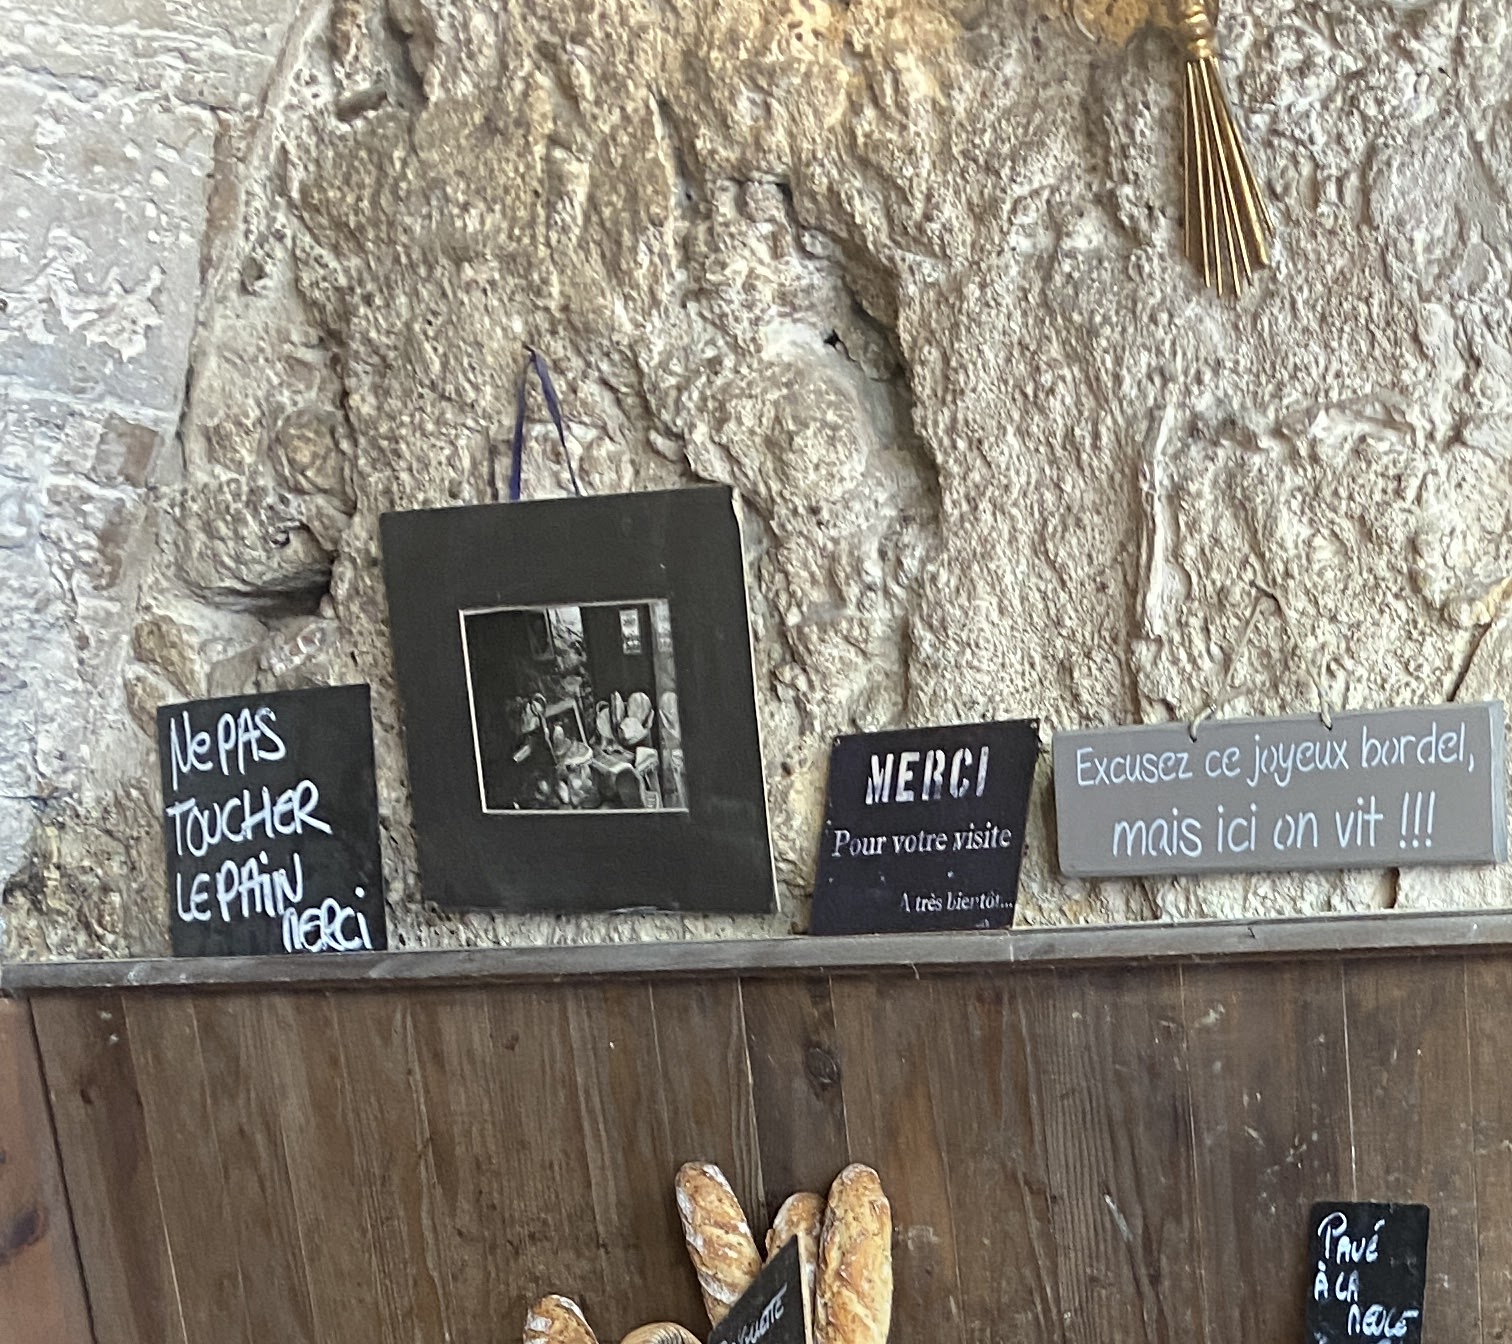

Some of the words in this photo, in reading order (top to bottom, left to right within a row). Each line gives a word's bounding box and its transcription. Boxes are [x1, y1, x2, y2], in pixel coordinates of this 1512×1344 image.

[216, 706, 287, 776] PAS
[1075, 744, 1194, 787] Excusez
[1204, 745, 1241, 777] ce
[1246, 733, 1350, 788] joyeux
[1360, 721, 1476, 774] bordel,
[864, 745, 990, 805] MERCI
[165, 779, 333, 857] TOUCHER
[831, 829, 887, 857] Pour
[891, 829, 949, 855] votre
[952, 821, 1013, 852] visite
[1112, 807, 1203, 858] mais
[1216, 802, 1257, 853] ici
[1272, 811, 1319, 849] on
[1334, 795, 1384, 848] vit
[1398, 790, 1436, 849] !!!
[176, 872, 212, 922] LE
[915, 892, 943, 912] très
[1317, 1211, 1386, 1264] PAVÉ
[1334, 1269, 1360, 1302] LA
[1347, 1303, 1420, 1338] MEULE
